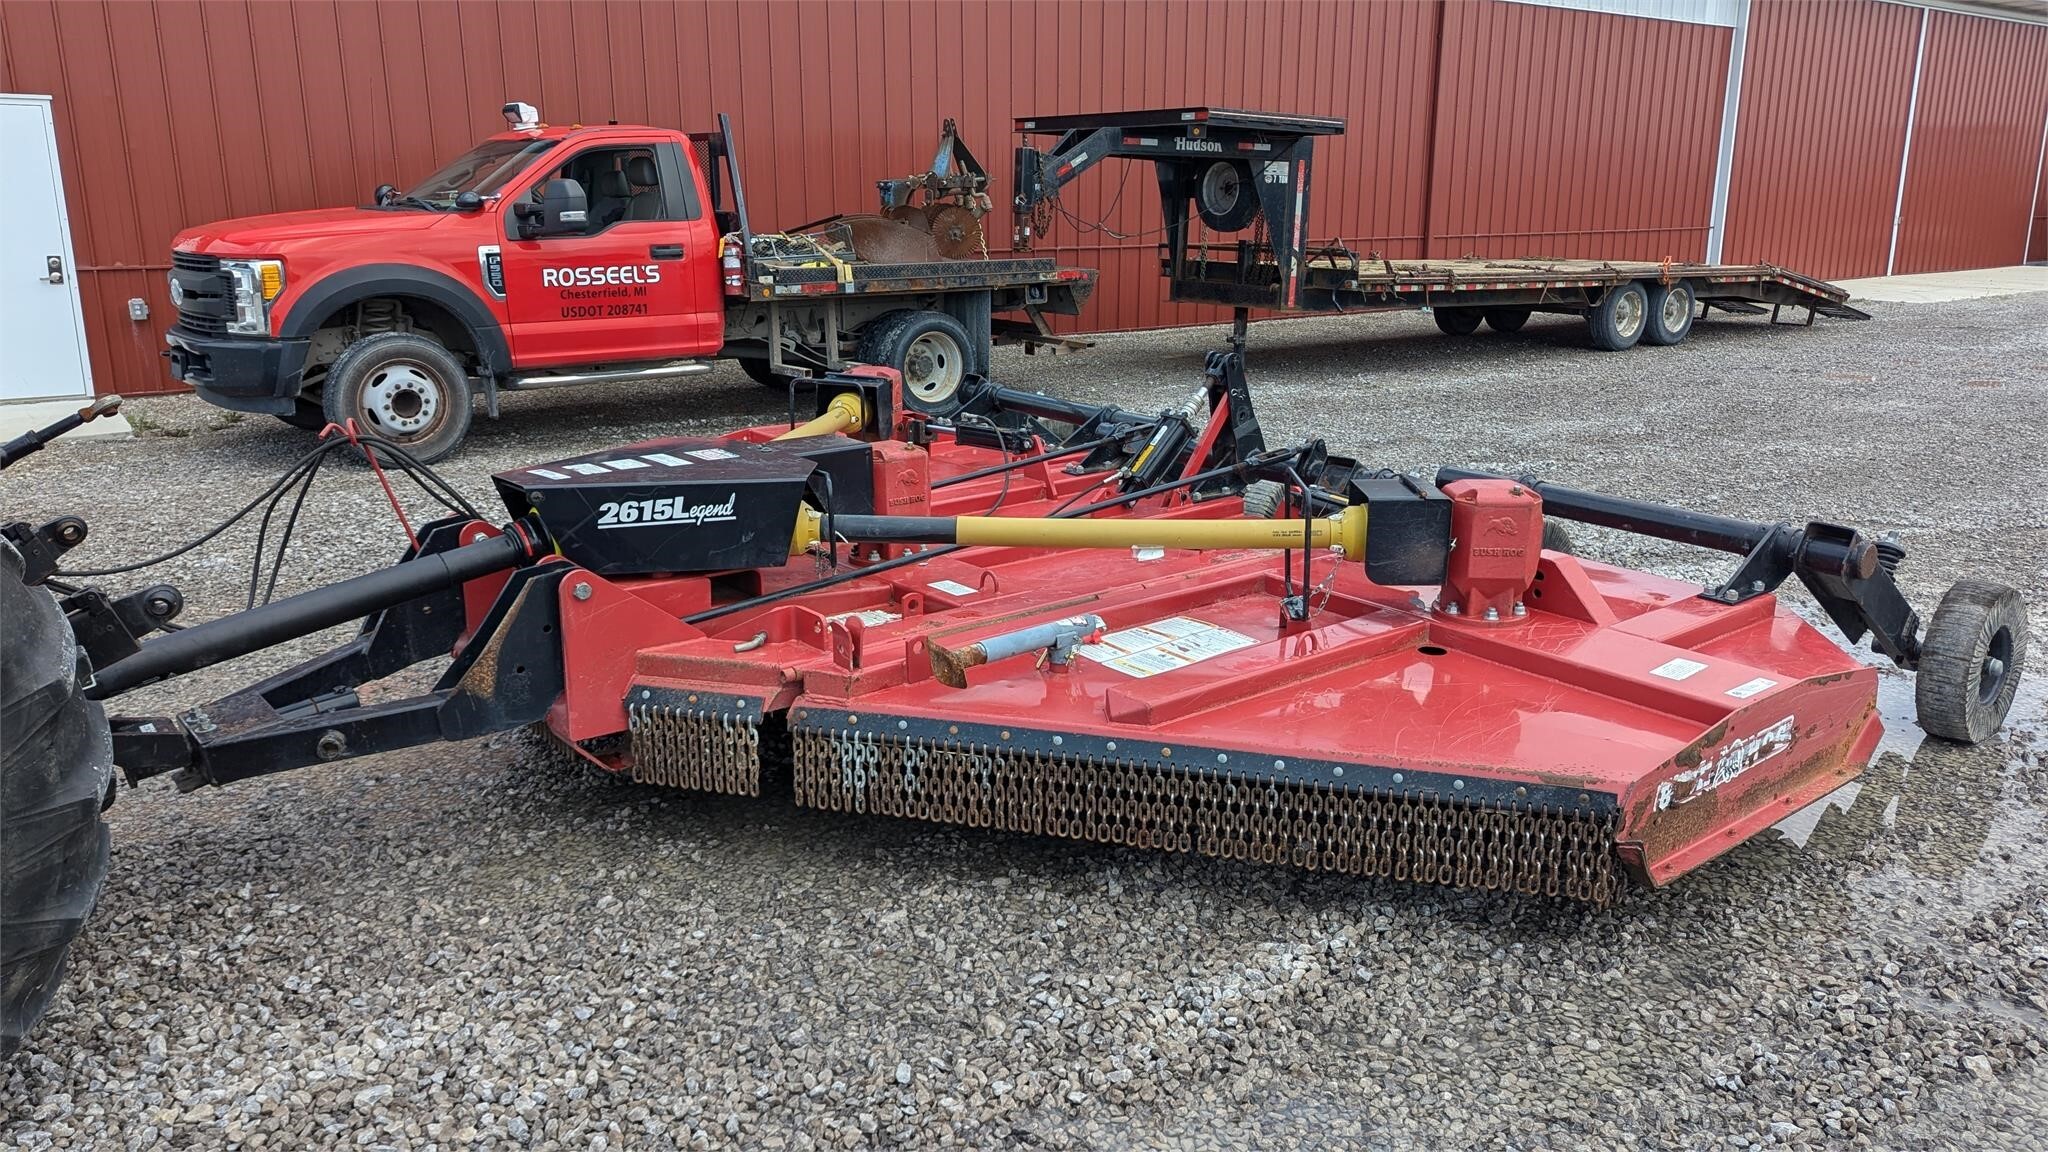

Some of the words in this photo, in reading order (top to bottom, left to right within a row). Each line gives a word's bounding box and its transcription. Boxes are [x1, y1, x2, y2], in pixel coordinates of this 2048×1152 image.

[1174, 136, 1223, 153] Hudson
[542, 264, 661, 288] ROSSEEL'S
[560, 288, 632, 300] Chesterfield,
[633, 286, 647, 297] MI
[561, 305, 604, 318] USDOT
[607, 303, 648, 316] 208741
